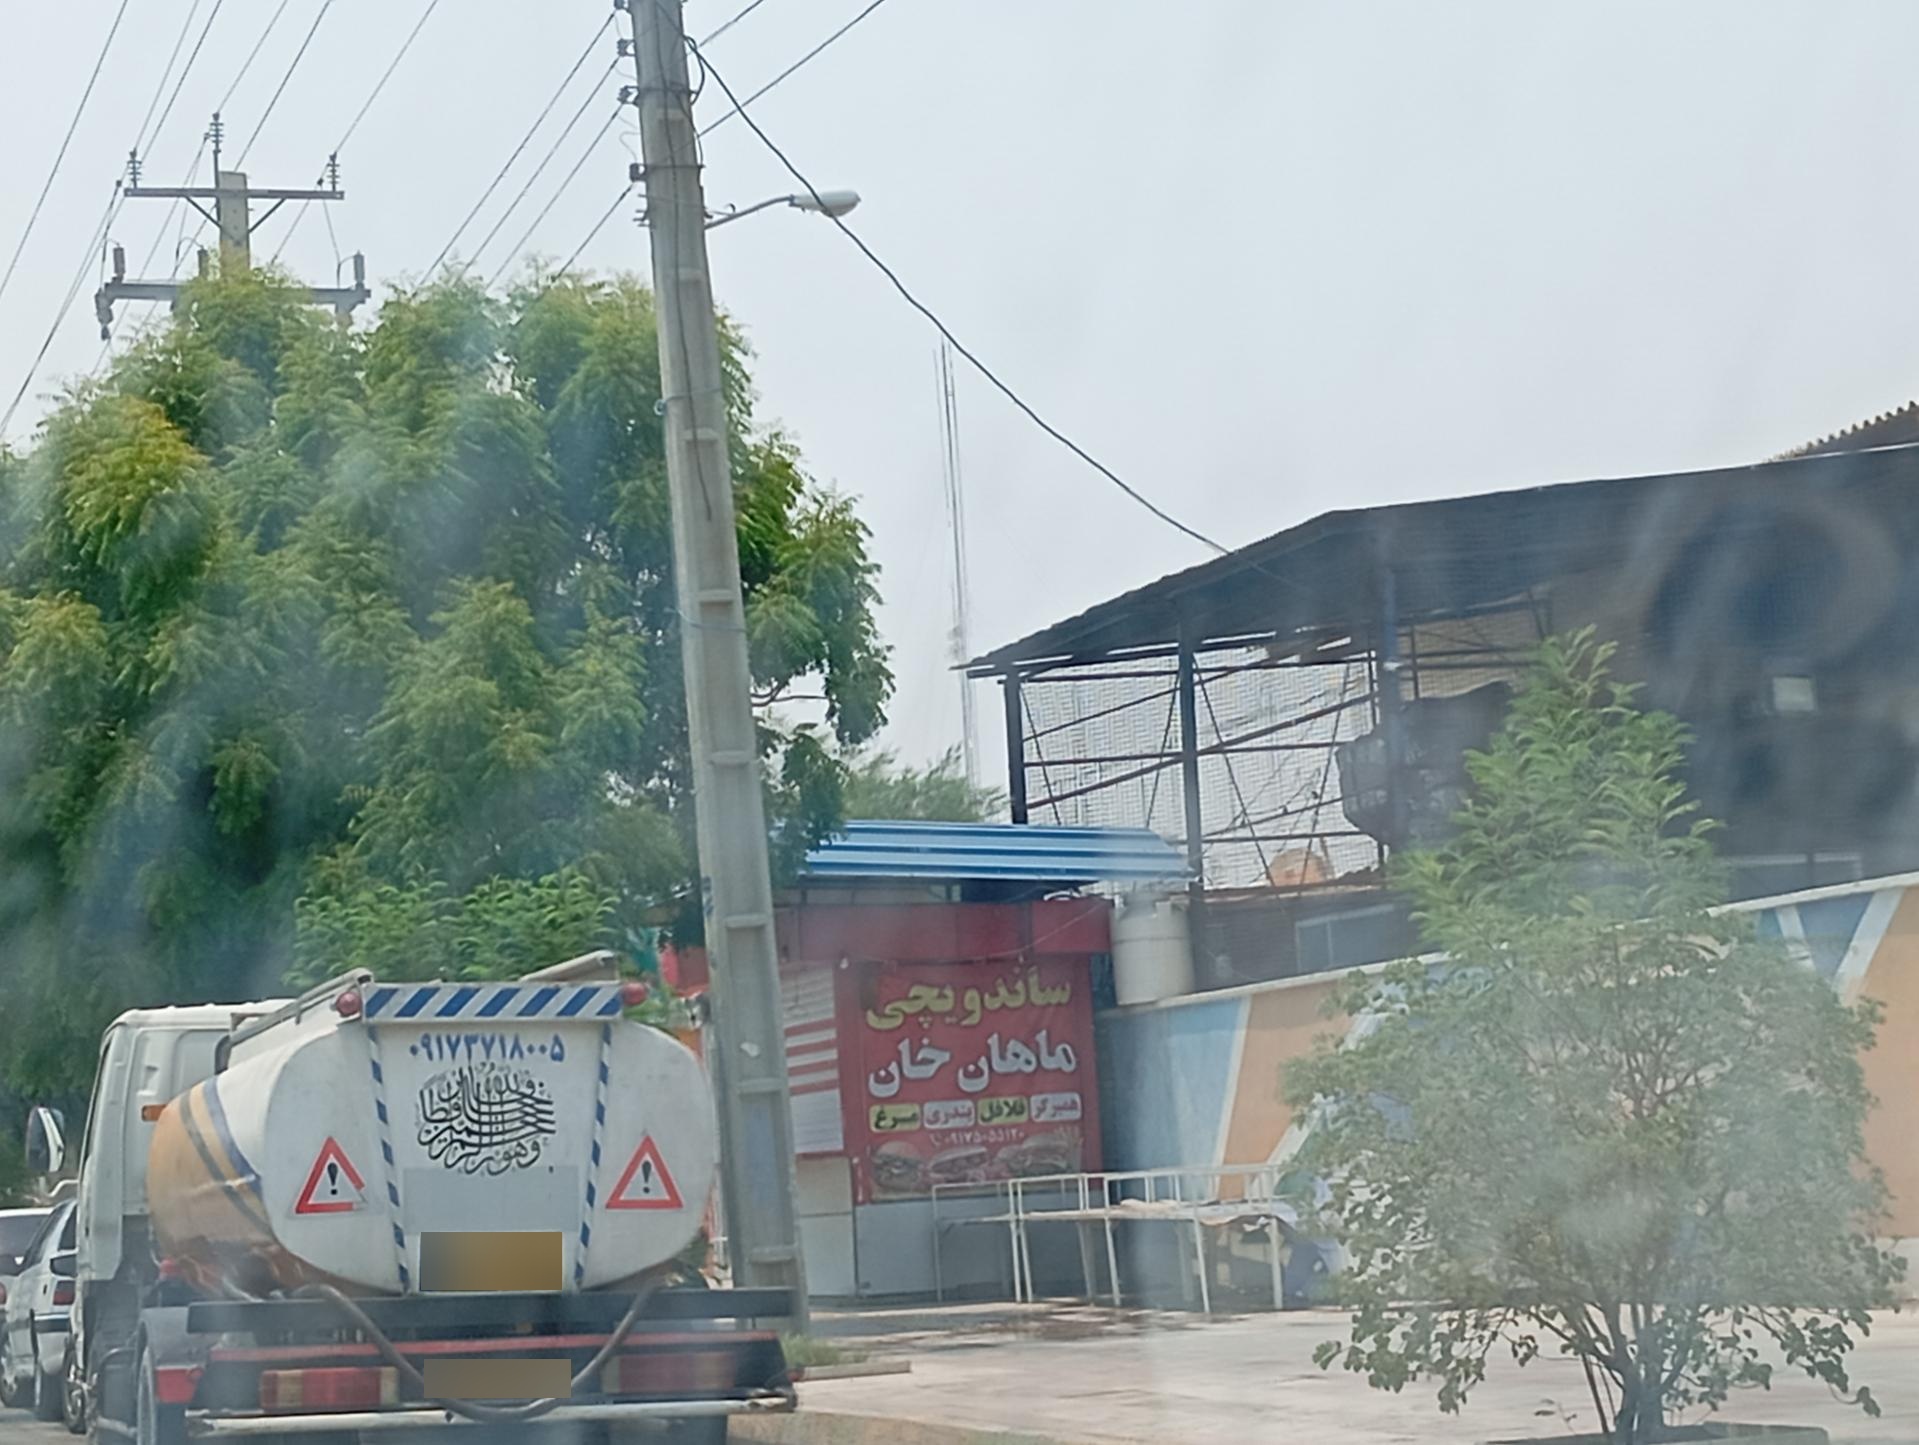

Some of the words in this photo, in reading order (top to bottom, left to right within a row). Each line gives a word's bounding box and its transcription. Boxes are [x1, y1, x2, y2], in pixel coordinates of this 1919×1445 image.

[409, 1033, 565, 1062] ۰۹۱۷۳۷۱۸۰۰۵
[868, 1037, 950, 1097] خان
[957, 1030, 1077, 1093] ماهان
[979, 1099, 1026, 1123] فلافل
